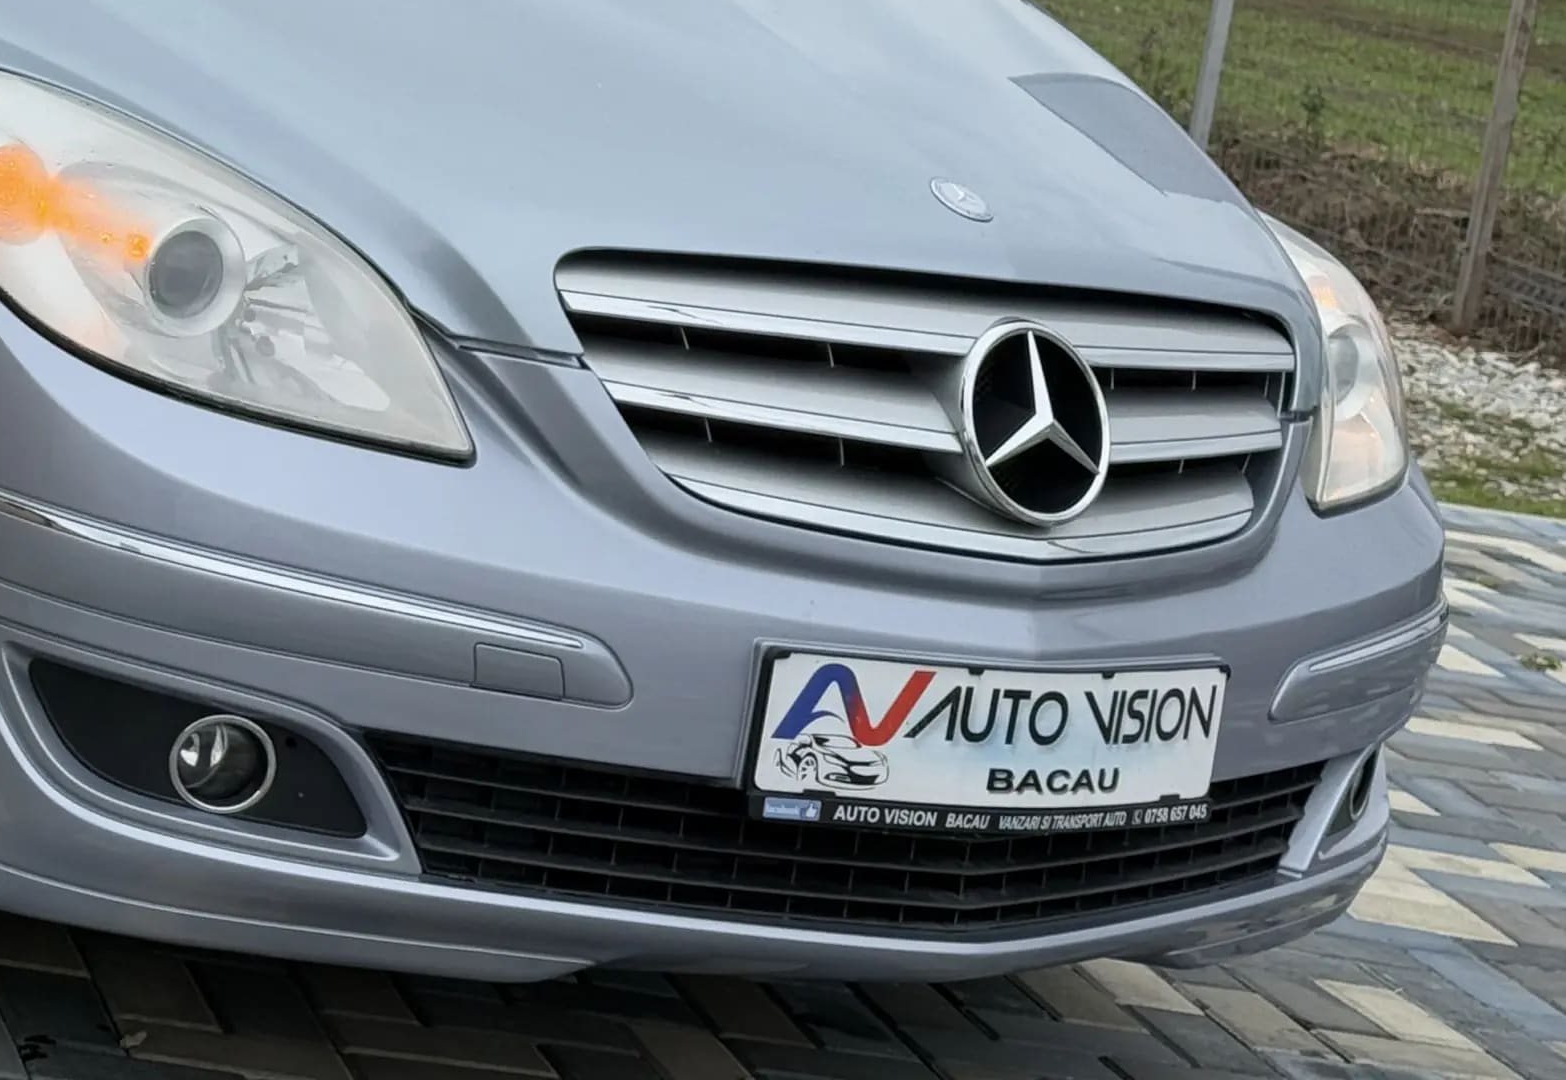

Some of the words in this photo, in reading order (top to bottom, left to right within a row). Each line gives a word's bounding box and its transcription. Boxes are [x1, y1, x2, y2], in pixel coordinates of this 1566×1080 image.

[904, 685, 1069, 746] AUTO
[1085, 684, 1217, 745] VISION
[986, 767, 1120, 795] BACAU
[834, 805, 880, 823] AUTO
[884, 808, 937, 827] VISION
[945, 813, 990, 829] BACAU
[1052, 813, 1104, 830] TRANSPORT
[1103, 812, 1127, 827] AUTO
[1170, 805, 1188, 822] 657
[1189, 803, 1207, 820] 045
